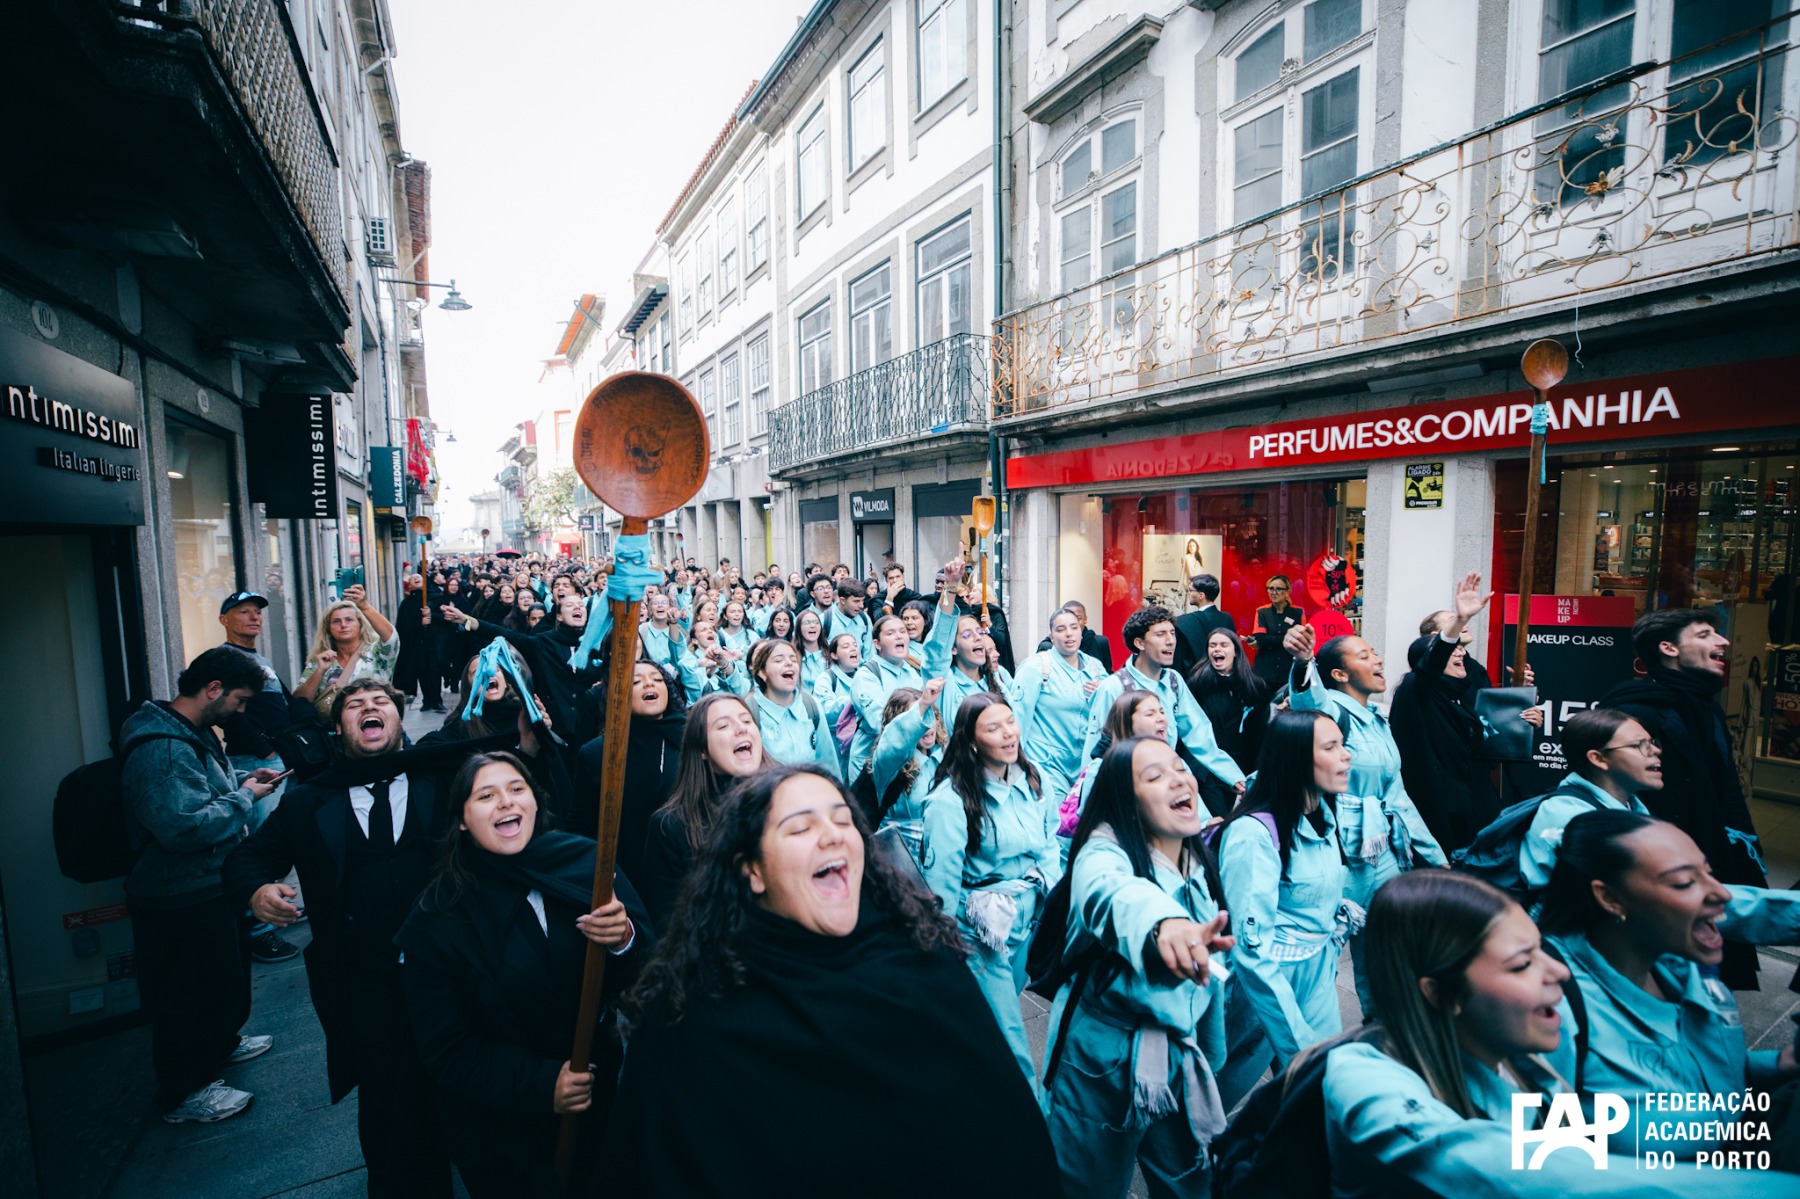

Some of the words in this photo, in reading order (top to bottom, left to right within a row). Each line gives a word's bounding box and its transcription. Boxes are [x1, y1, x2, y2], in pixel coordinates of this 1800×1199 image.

[54, 447, 97, 474] Italian
[99, 457, 141, 482] lingerie
[392, 450, 404, 504] CALZEDONIA
[863, 500, 890, 512] VILMODA
[1557, 598, 1571, 607] MA
[1557, 607, 1570, 615] KE
[1557, 615, 1571, 624] UP
[1572, 635, 1614, 647] CLASS
[1536, 700, 1600, 737] 15
